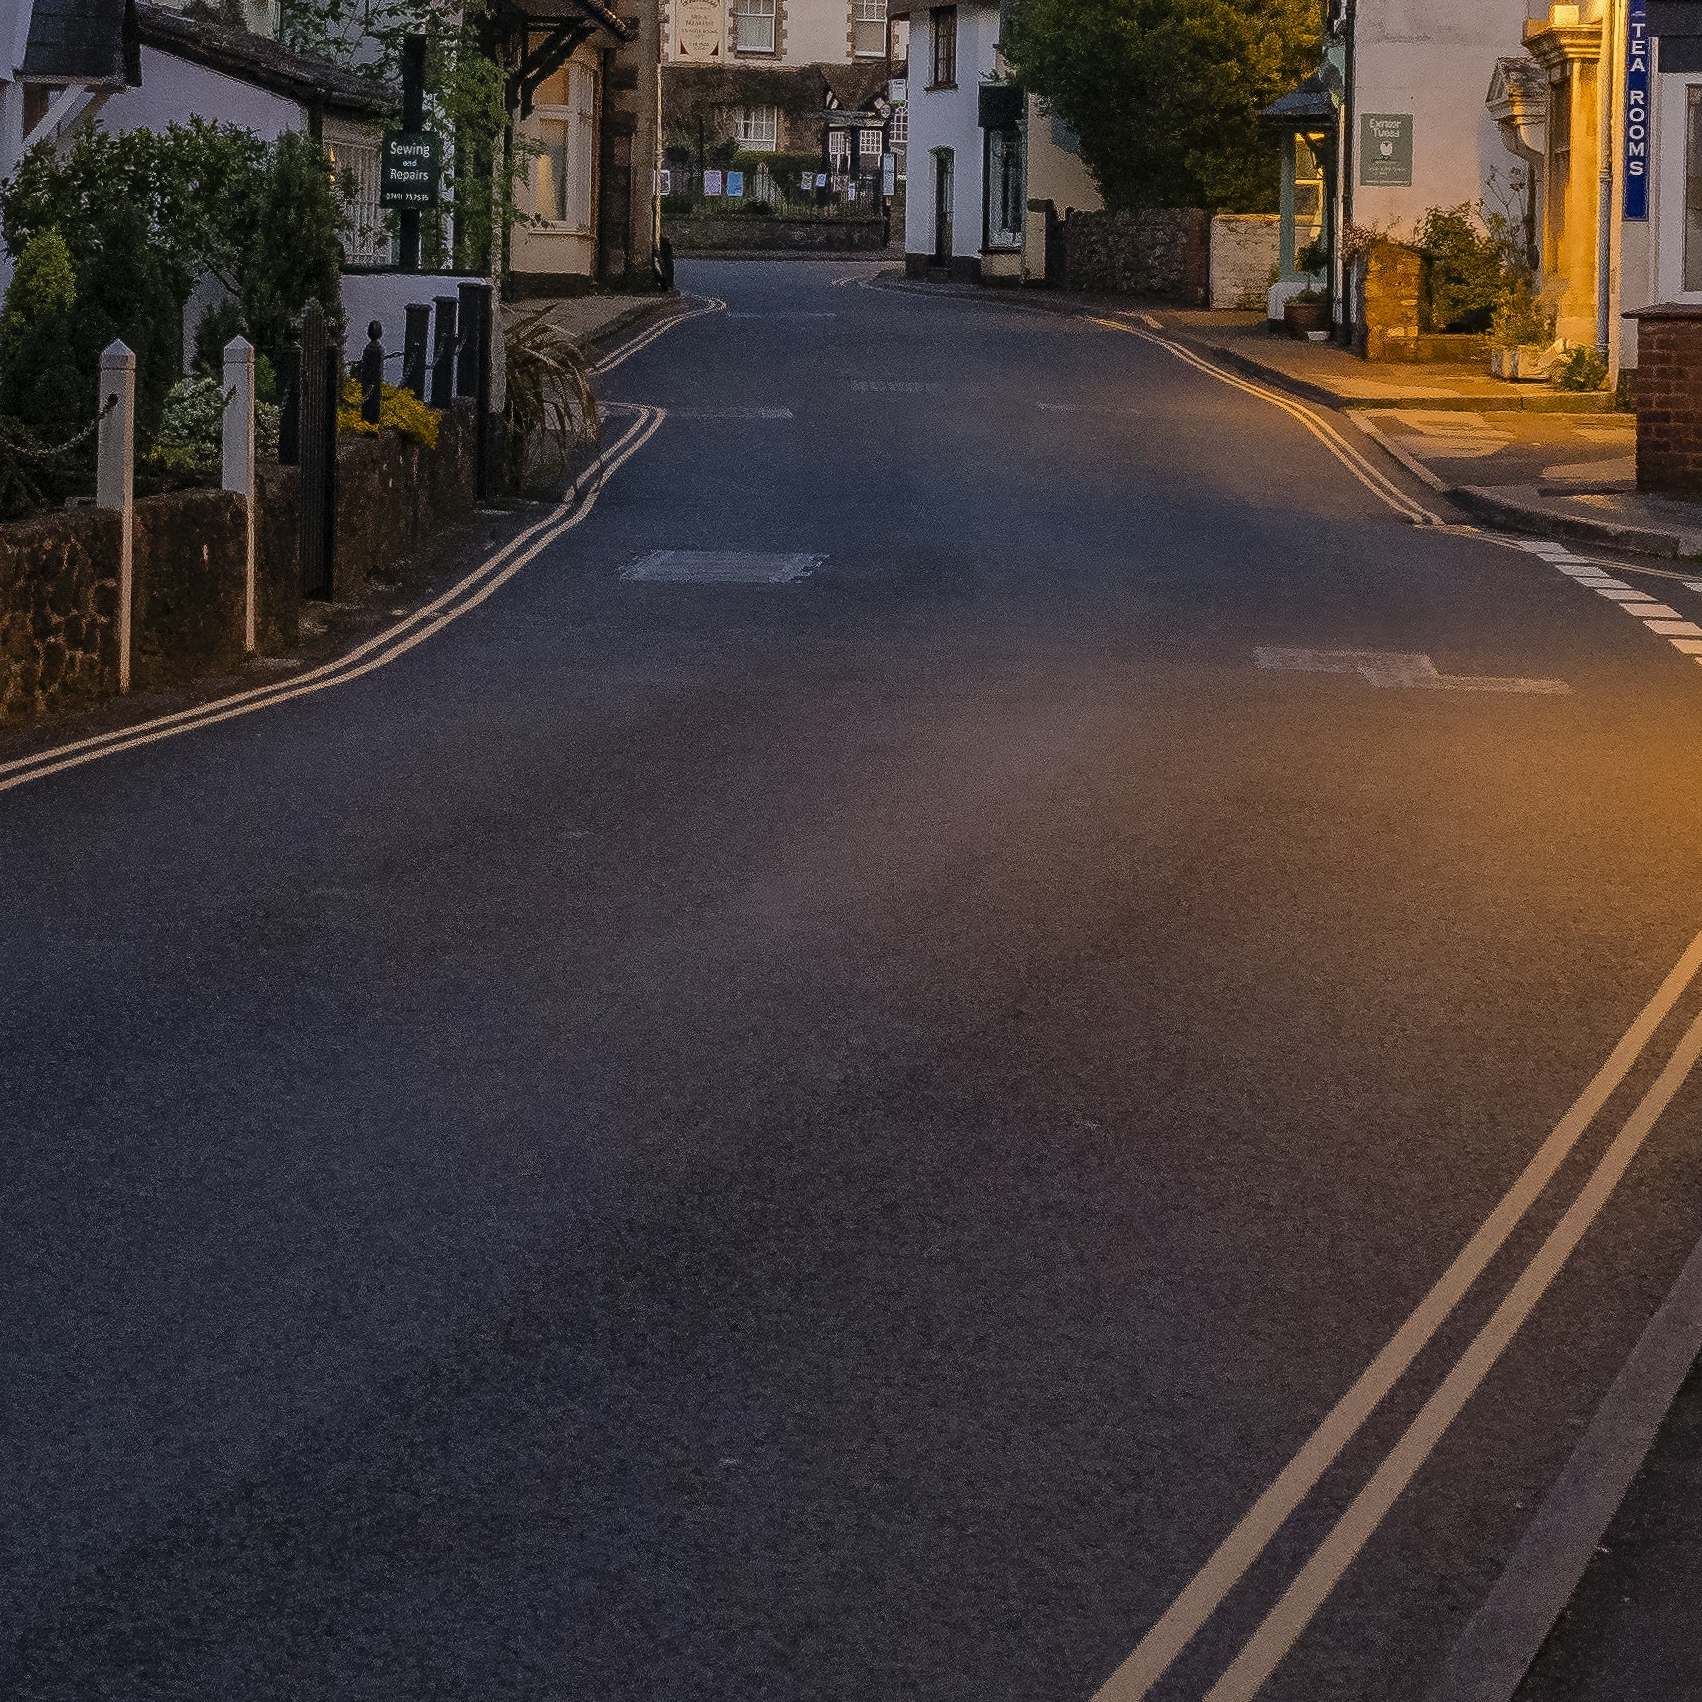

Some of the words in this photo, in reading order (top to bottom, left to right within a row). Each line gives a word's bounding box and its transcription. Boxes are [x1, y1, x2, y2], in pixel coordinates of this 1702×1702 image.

[1630, 23, 1646, 72] TEA
[1629, 90, 1646, 176] ROOMS
[389, 141, 430, 158] Sewing
[402, 159, 417, 167] and
[389, 168, 429, 182] Repairs
